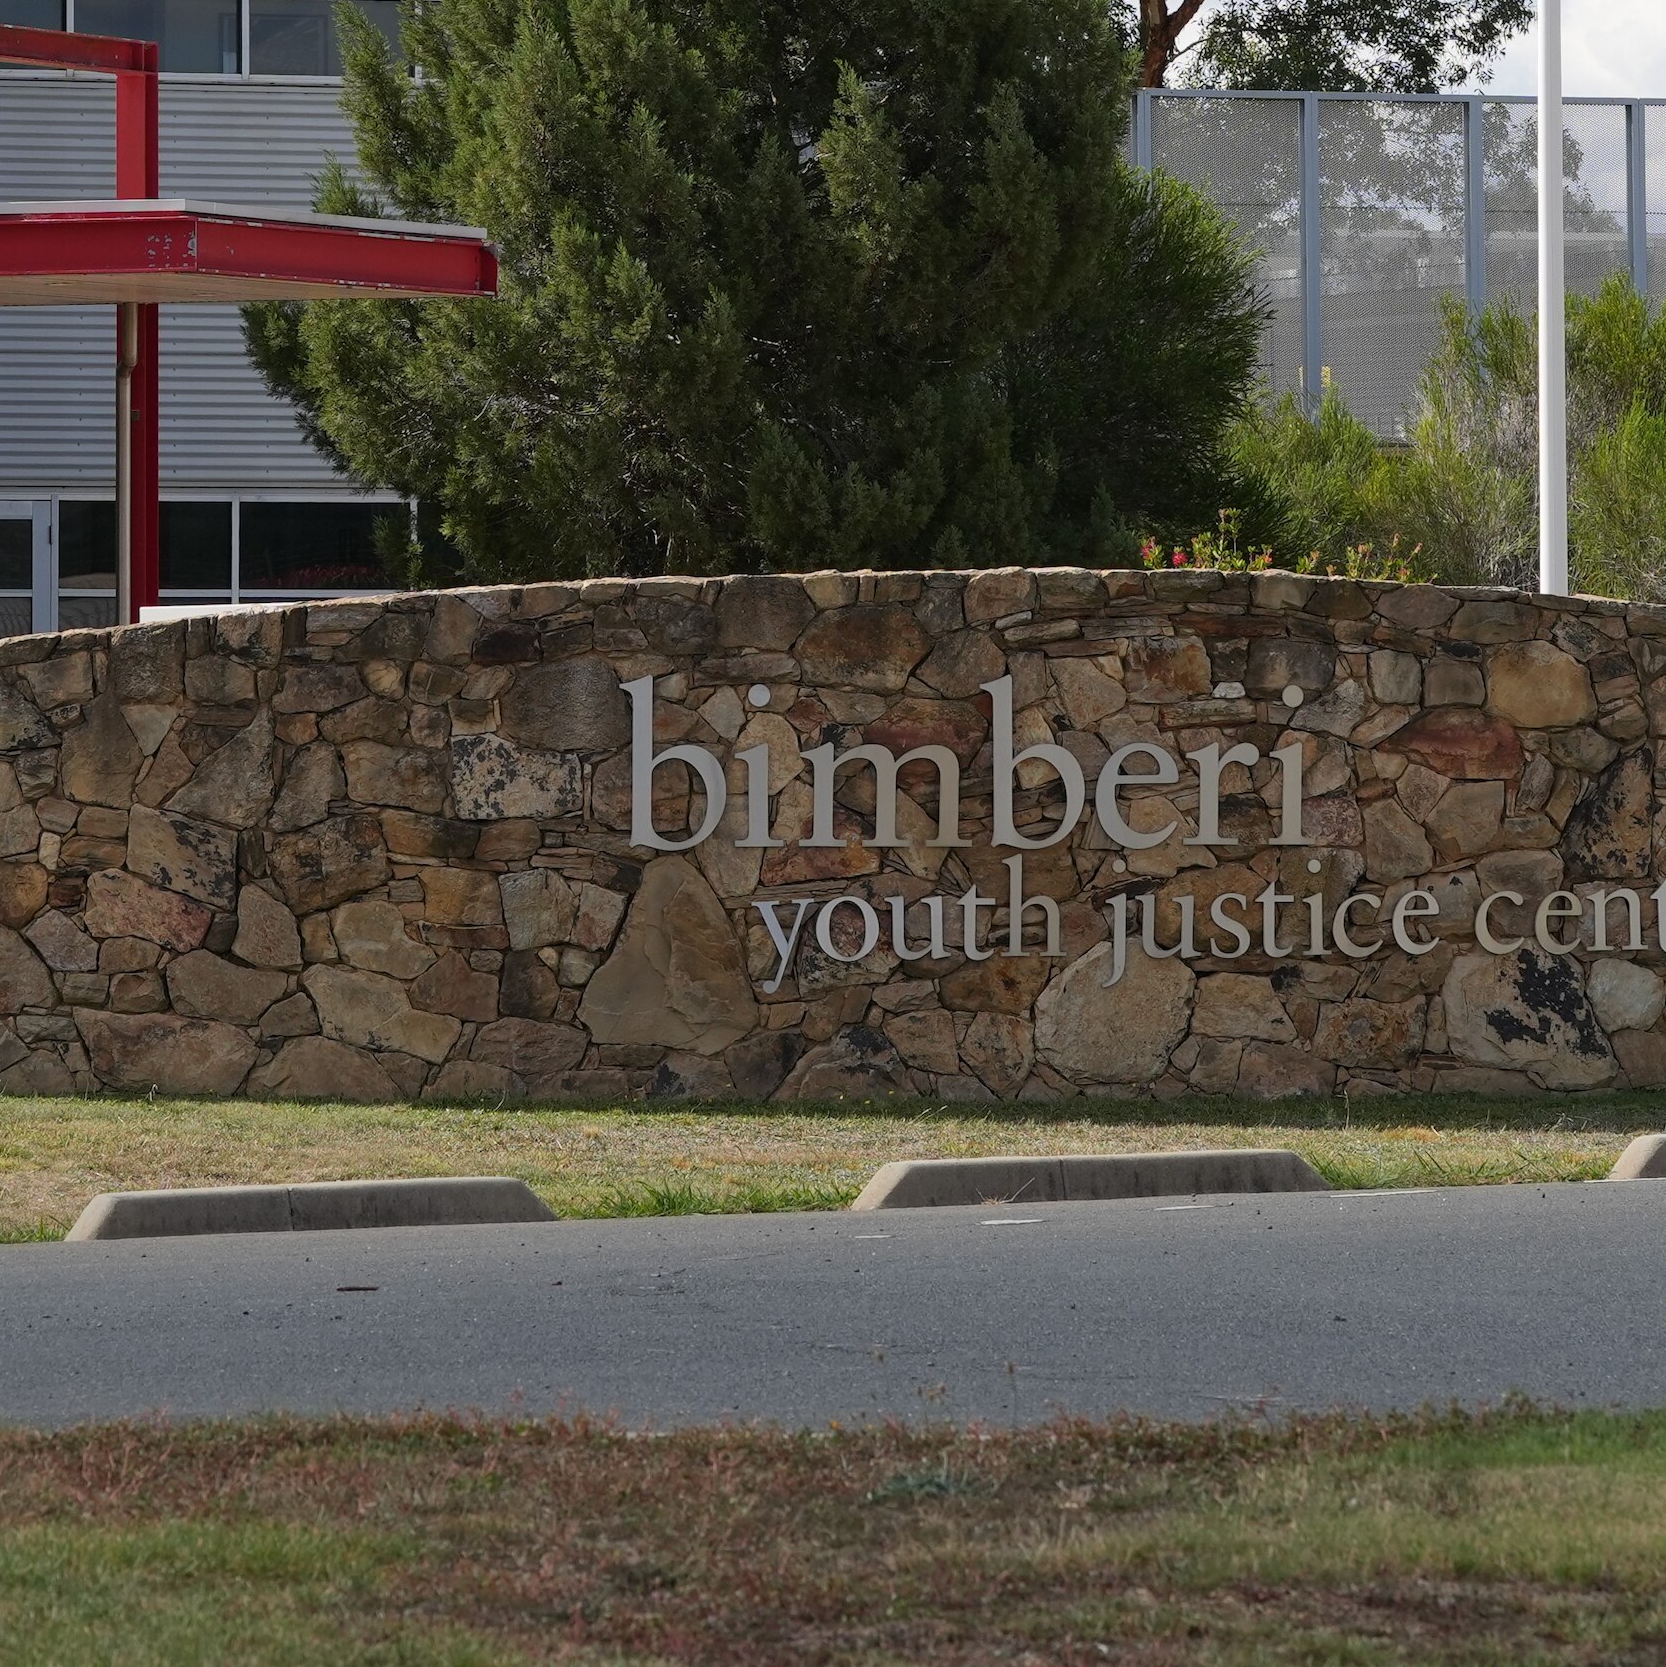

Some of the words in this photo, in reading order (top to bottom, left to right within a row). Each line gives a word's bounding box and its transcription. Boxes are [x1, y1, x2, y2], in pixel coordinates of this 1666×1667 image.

[619, 674, 1317, 852] bimberi
[751, 853, 1068, 994] youth
[1101, 858, 1440, 989] justice
